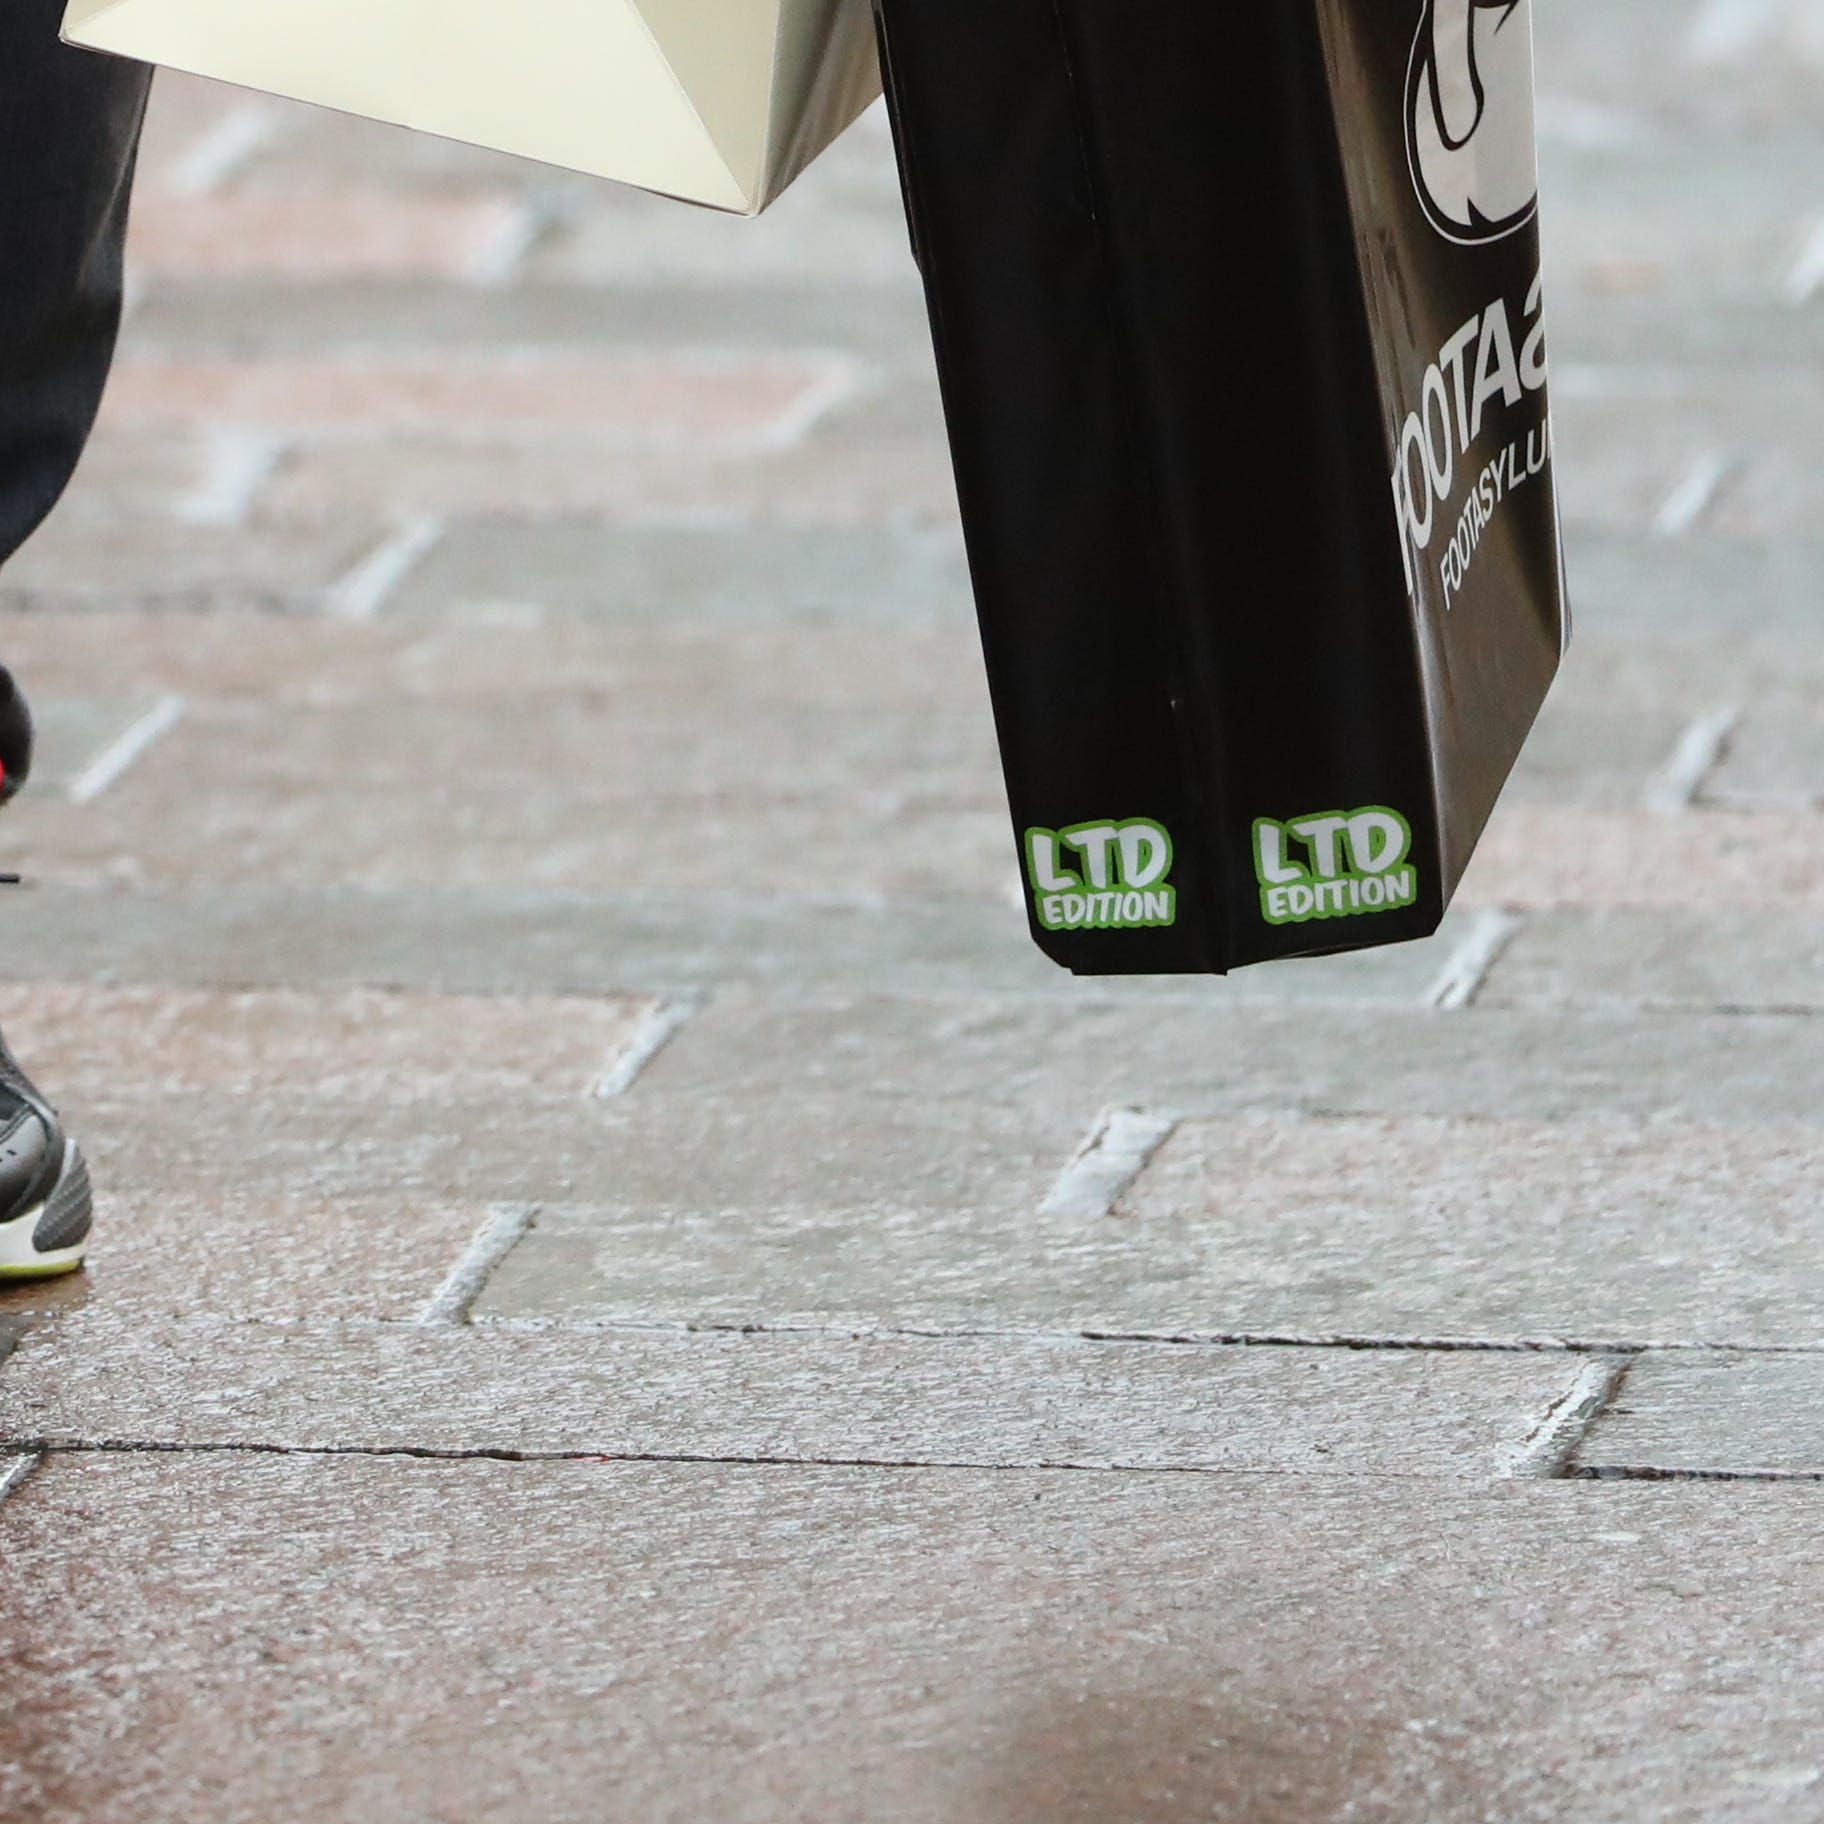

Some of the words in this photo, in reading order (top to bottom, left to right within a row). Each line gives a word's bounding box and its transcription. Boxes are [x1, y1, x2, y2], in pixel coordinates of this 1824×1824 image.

[1440, 418, 1551, 612] FOOTASYLU
[1031, 824, 1168, 892] LTD
[1258, 811, 1405, 884] LTD
[1042, 890, 1170, 924] EDITION
[1266, 869, 1412, 917] EDITION
